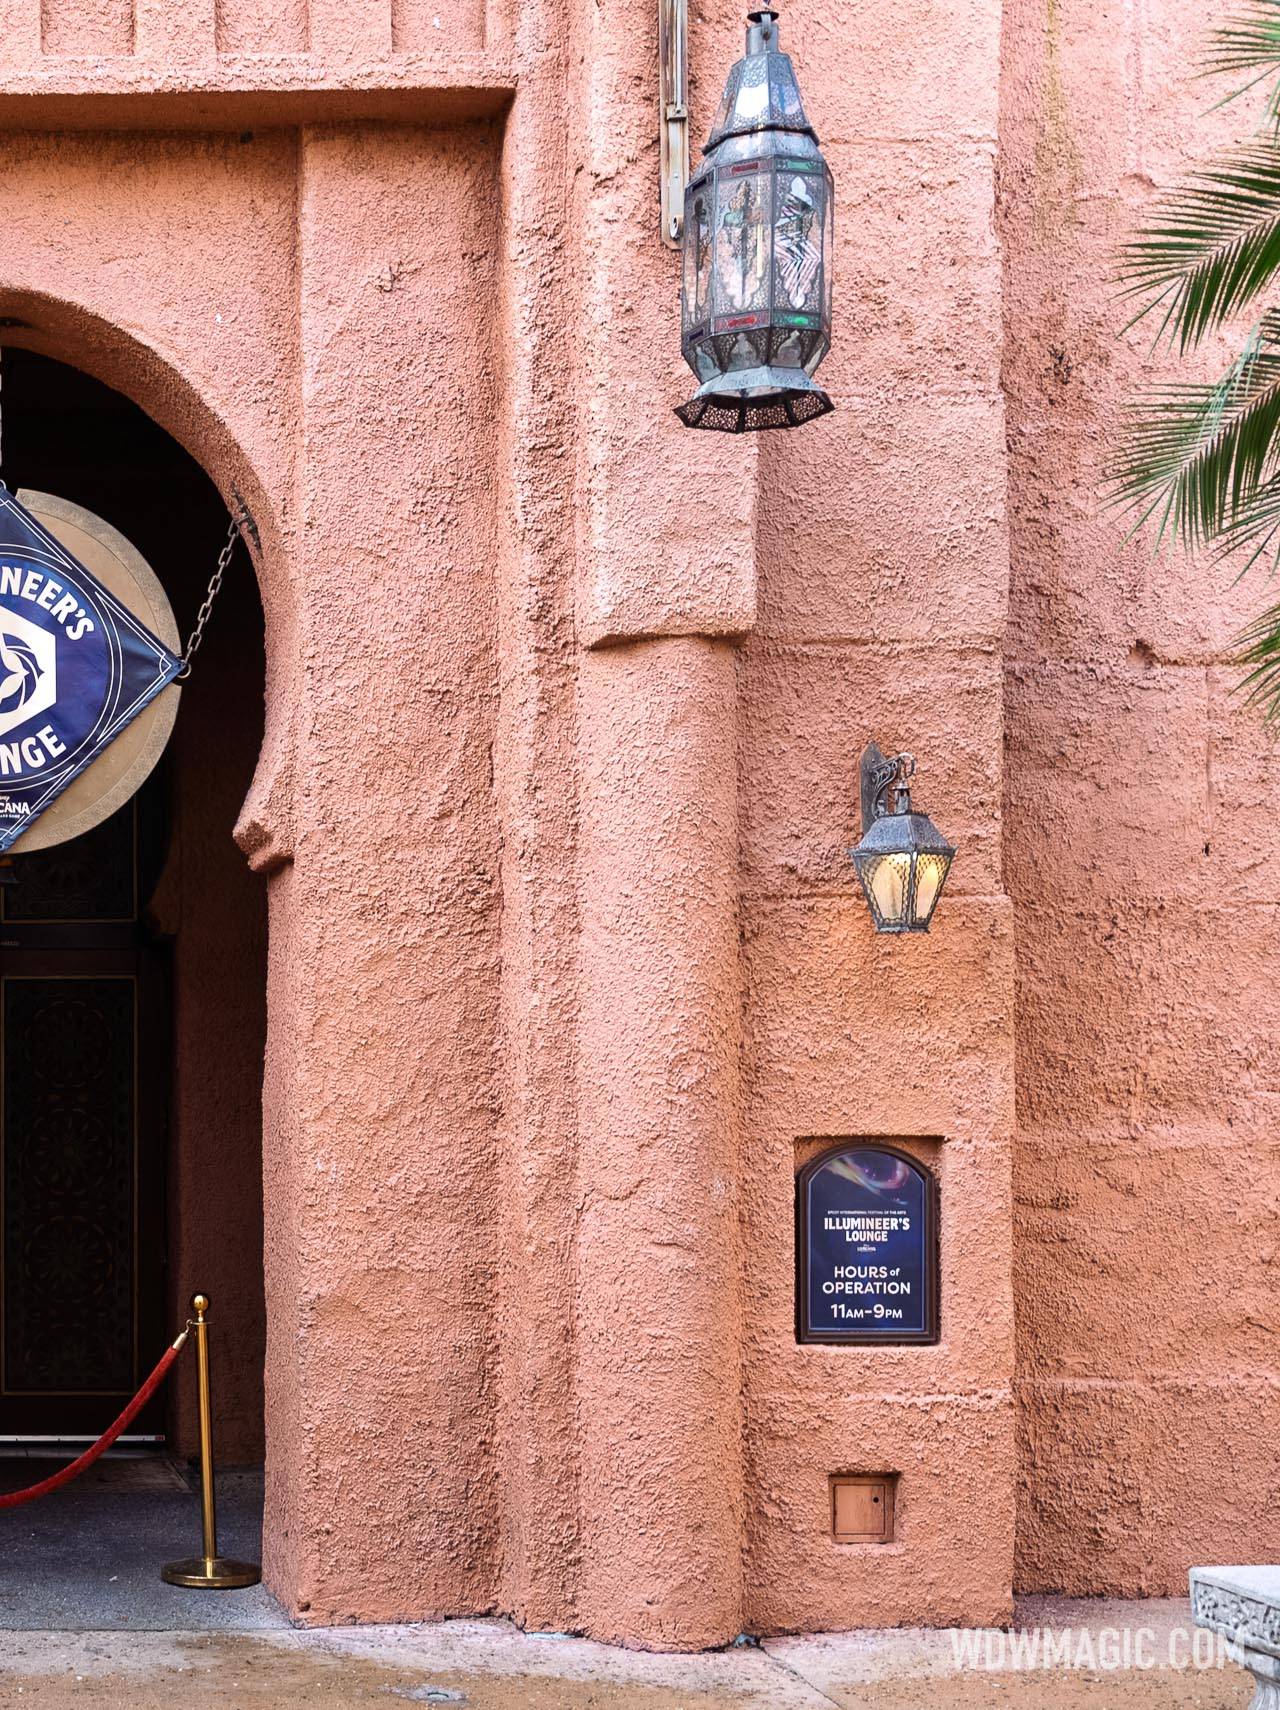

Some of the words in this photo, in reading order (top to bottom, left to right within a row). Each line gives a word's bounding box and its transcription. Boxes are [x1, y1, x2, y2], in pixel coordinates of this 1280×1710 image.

[824, 1217, 910, 1230] ILLUMINEER'S
[845, 1230, 888, 1242] LOUNGE
[834, 1266, 888, 1278] HOURS
[889, 1267, 900, 1277] of
[822, 1282, 911, 1294] OPERATION
